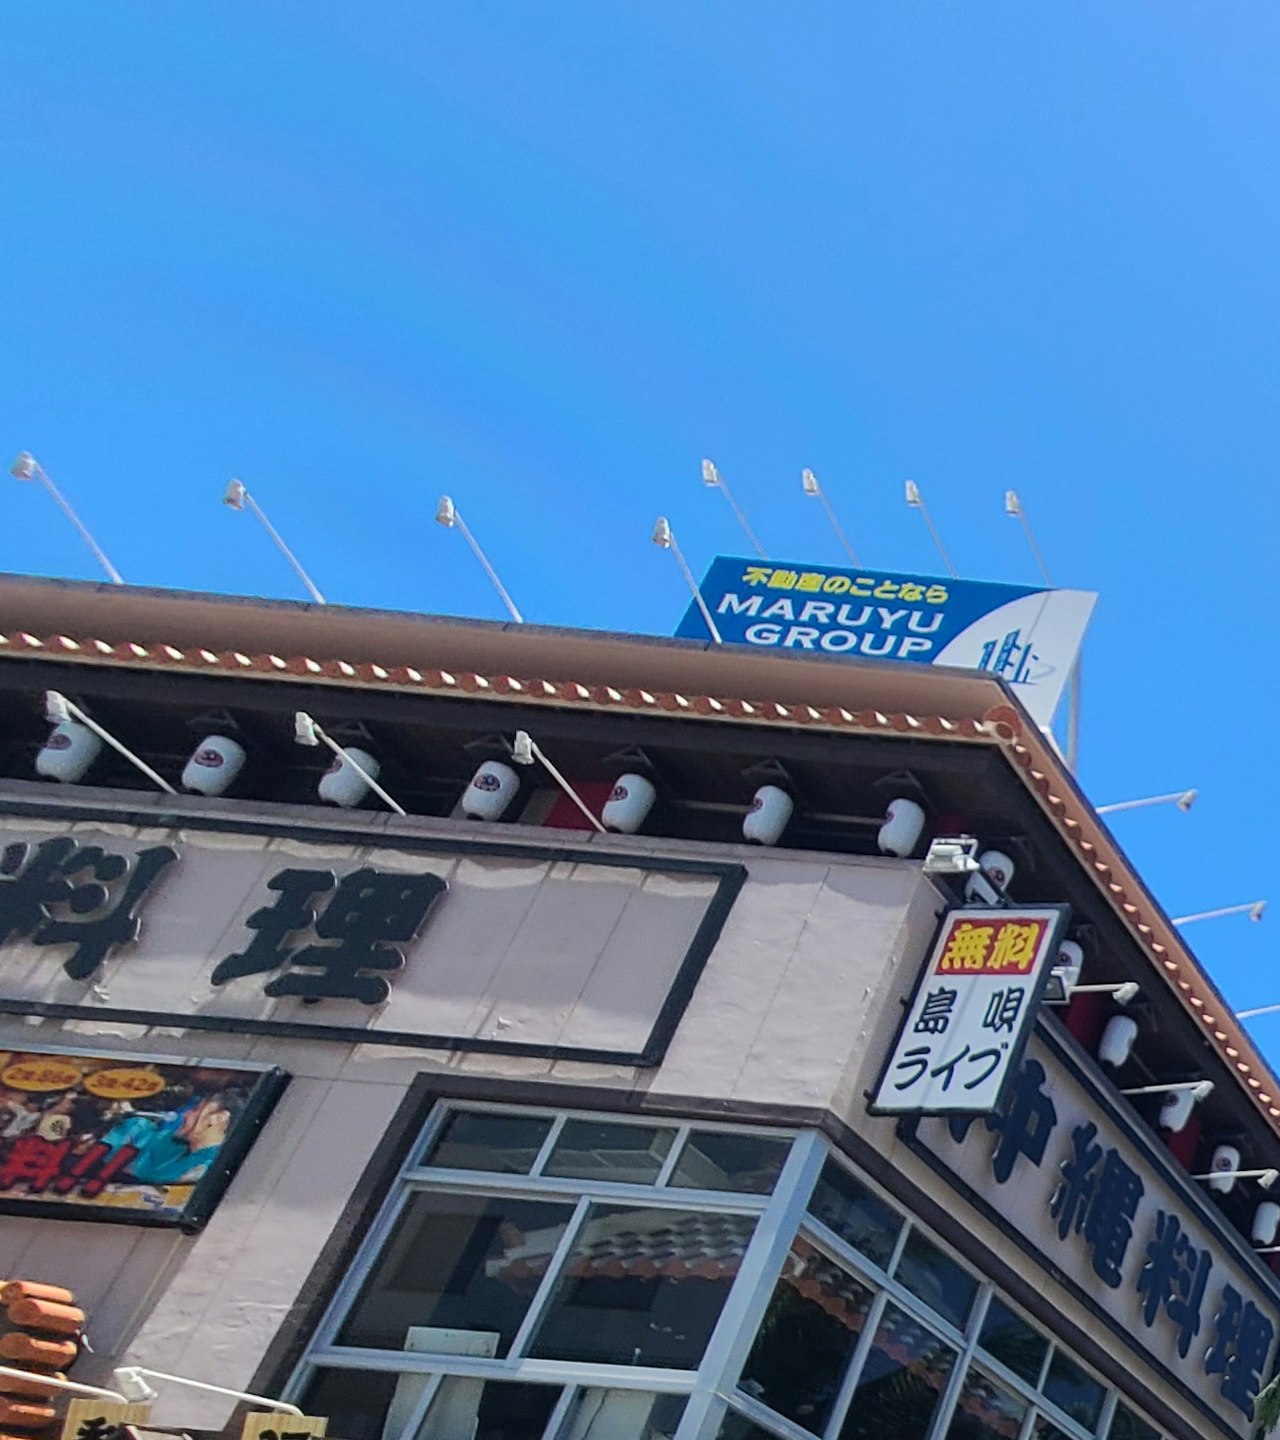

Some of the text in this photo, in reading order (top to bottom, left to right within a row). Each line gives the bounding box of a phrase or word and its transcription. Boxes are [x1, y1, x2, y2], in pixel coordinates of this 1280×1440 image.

[742, 566, 949, 604] 不動産のことなら
[717, 593, 945, 634] MARUYU
[744, 624, 934, 659] GROUP
[941, 922, 1040, 970] 無料
[913, 985, 1025, 1035] 島唄
[894, 1042, 1009, 1092] ライブ
